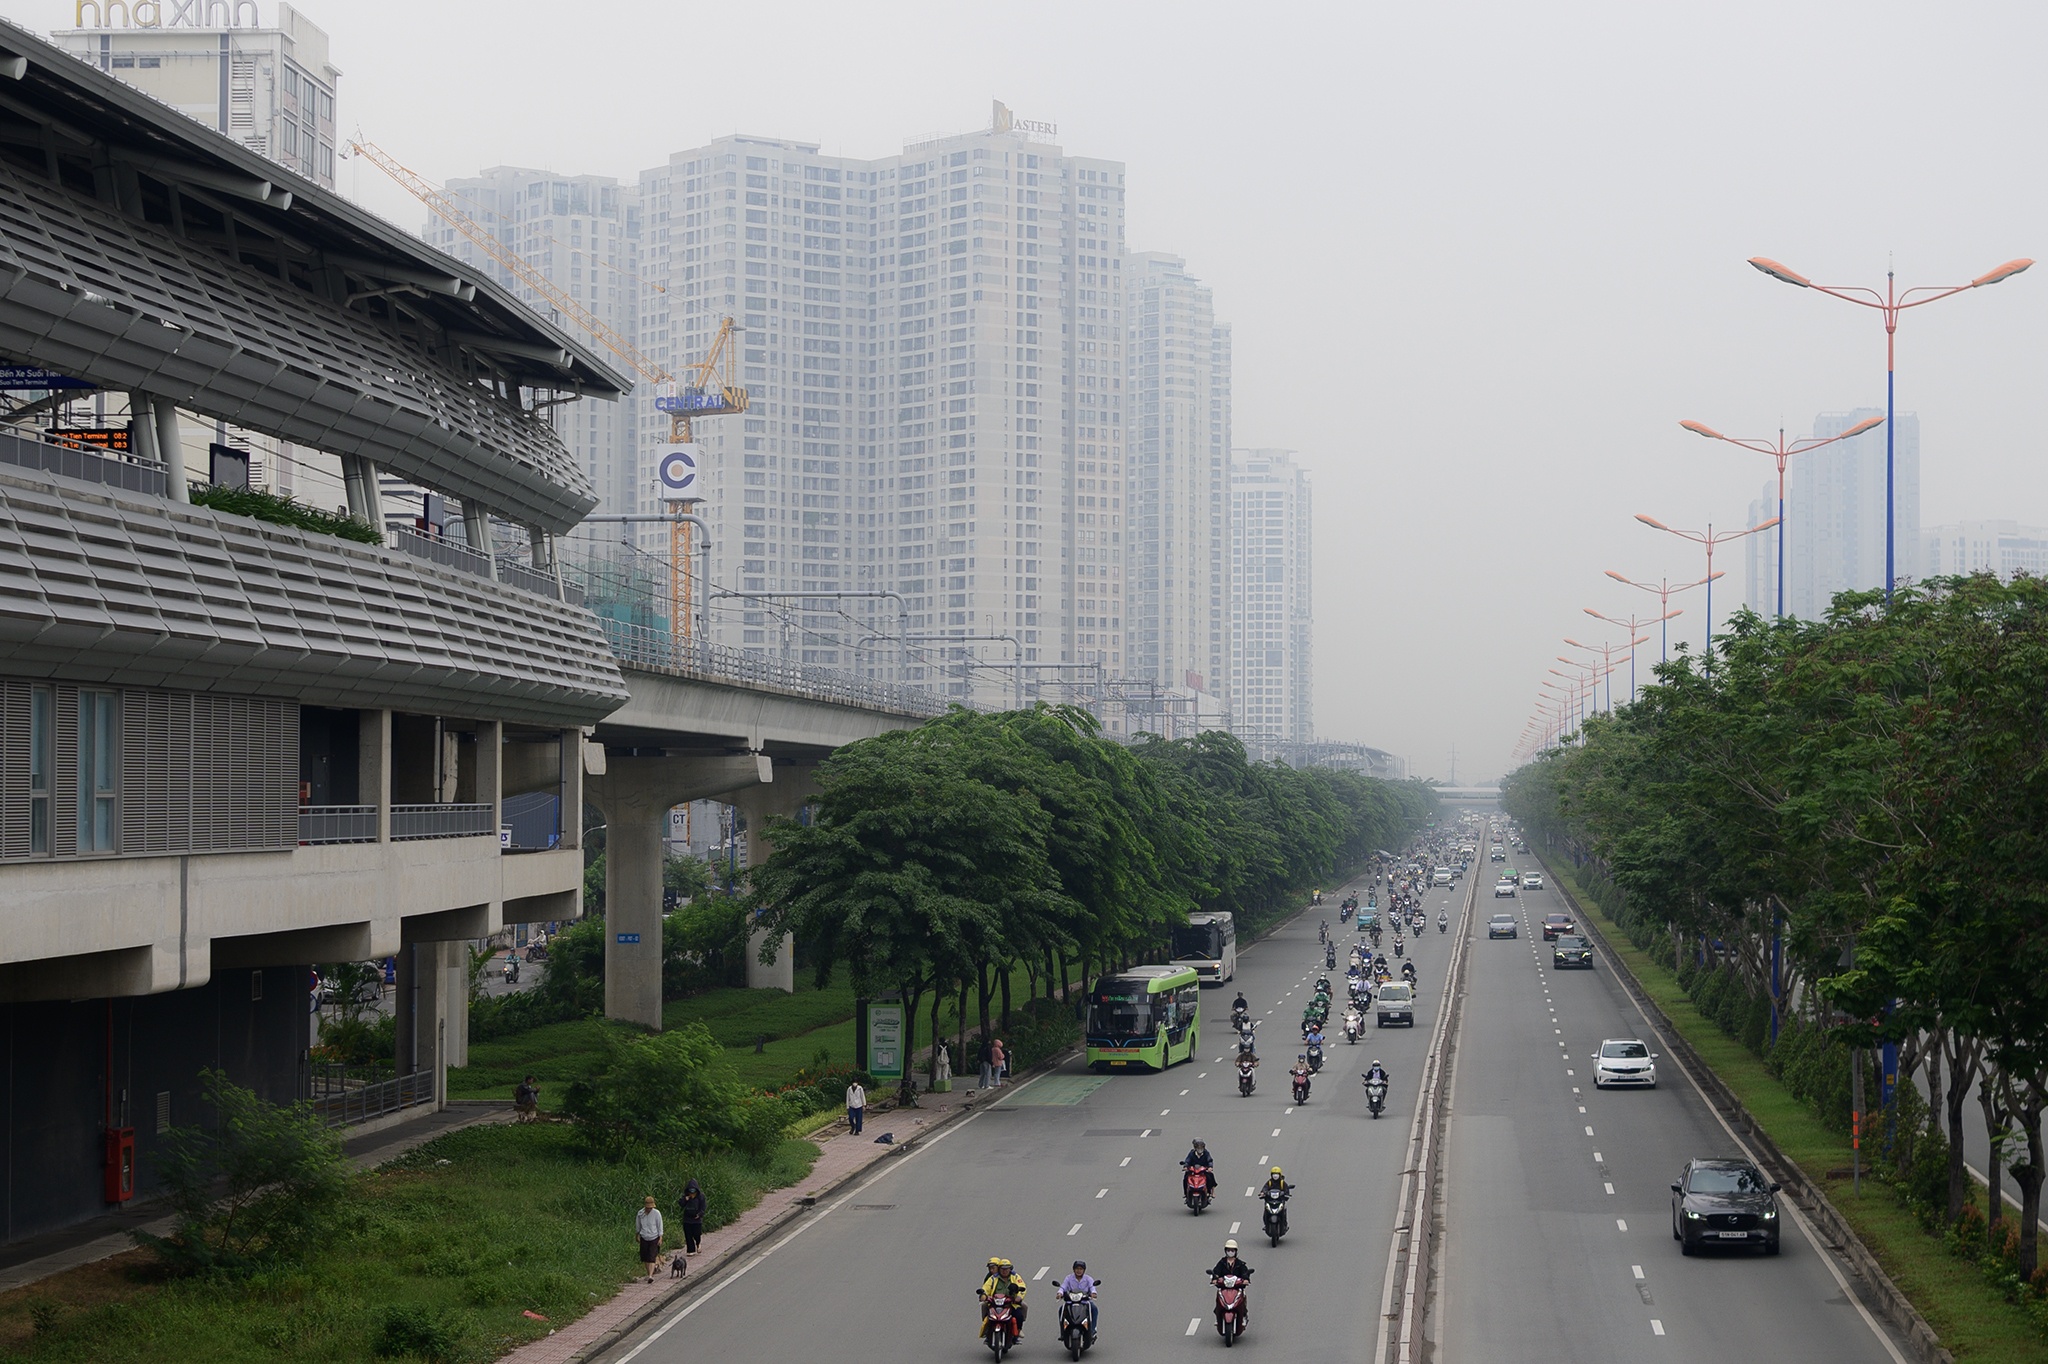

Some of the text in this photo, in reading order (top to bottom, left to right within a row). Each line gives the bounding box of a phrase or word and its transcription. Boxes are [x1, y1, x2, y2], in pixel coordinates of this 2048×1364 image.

[15, 369, 26, 378] Xe
[655, 395, 726, 411] CENTRAL
[83, 432, 109, 440] Terminal
[673, 814, 685, 824] CT
